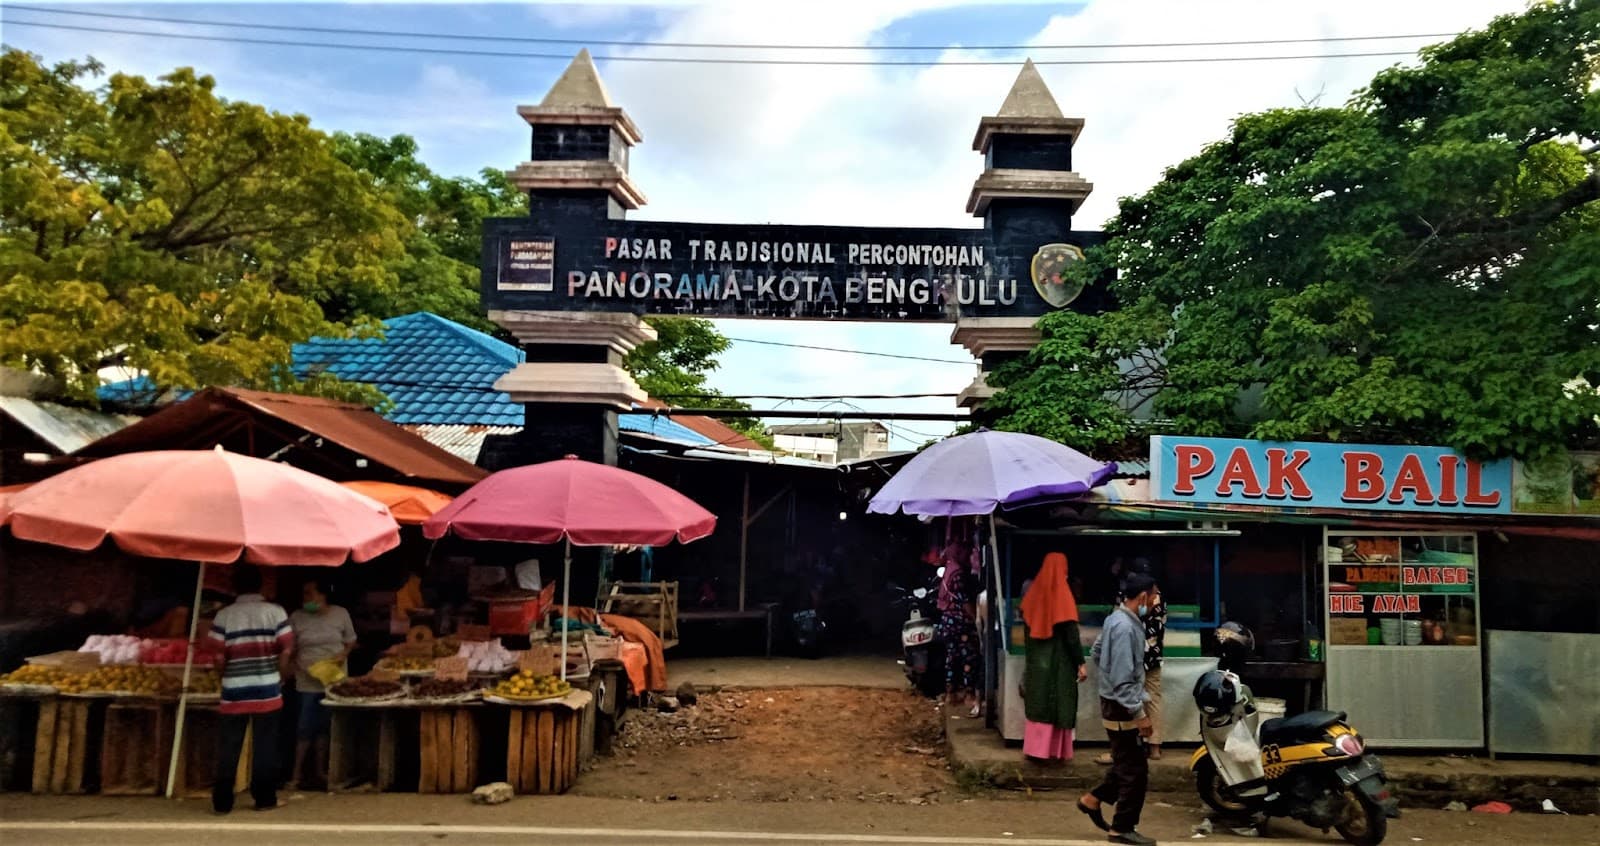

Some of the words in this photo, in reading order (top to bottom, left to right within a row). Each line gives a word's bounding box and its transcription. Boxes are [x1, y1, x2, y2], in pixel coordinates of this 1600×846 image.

[605, 237, 672, 260] PASAR
[689, 240, 835, 263] TRADISIONAL
[848, 243, 984, 266] PERCONTOHAN
[846, 276, 1017, 306] BENGKULU
[1173, 445, 1313, 500] PAK
[1340, 450, 1502, 507] BAIL
[1403, 567, 1469, 585] BAKSO
[1329, 594, 1364, 613] MIE
[1372, 595, 1421, 613] AYAM
